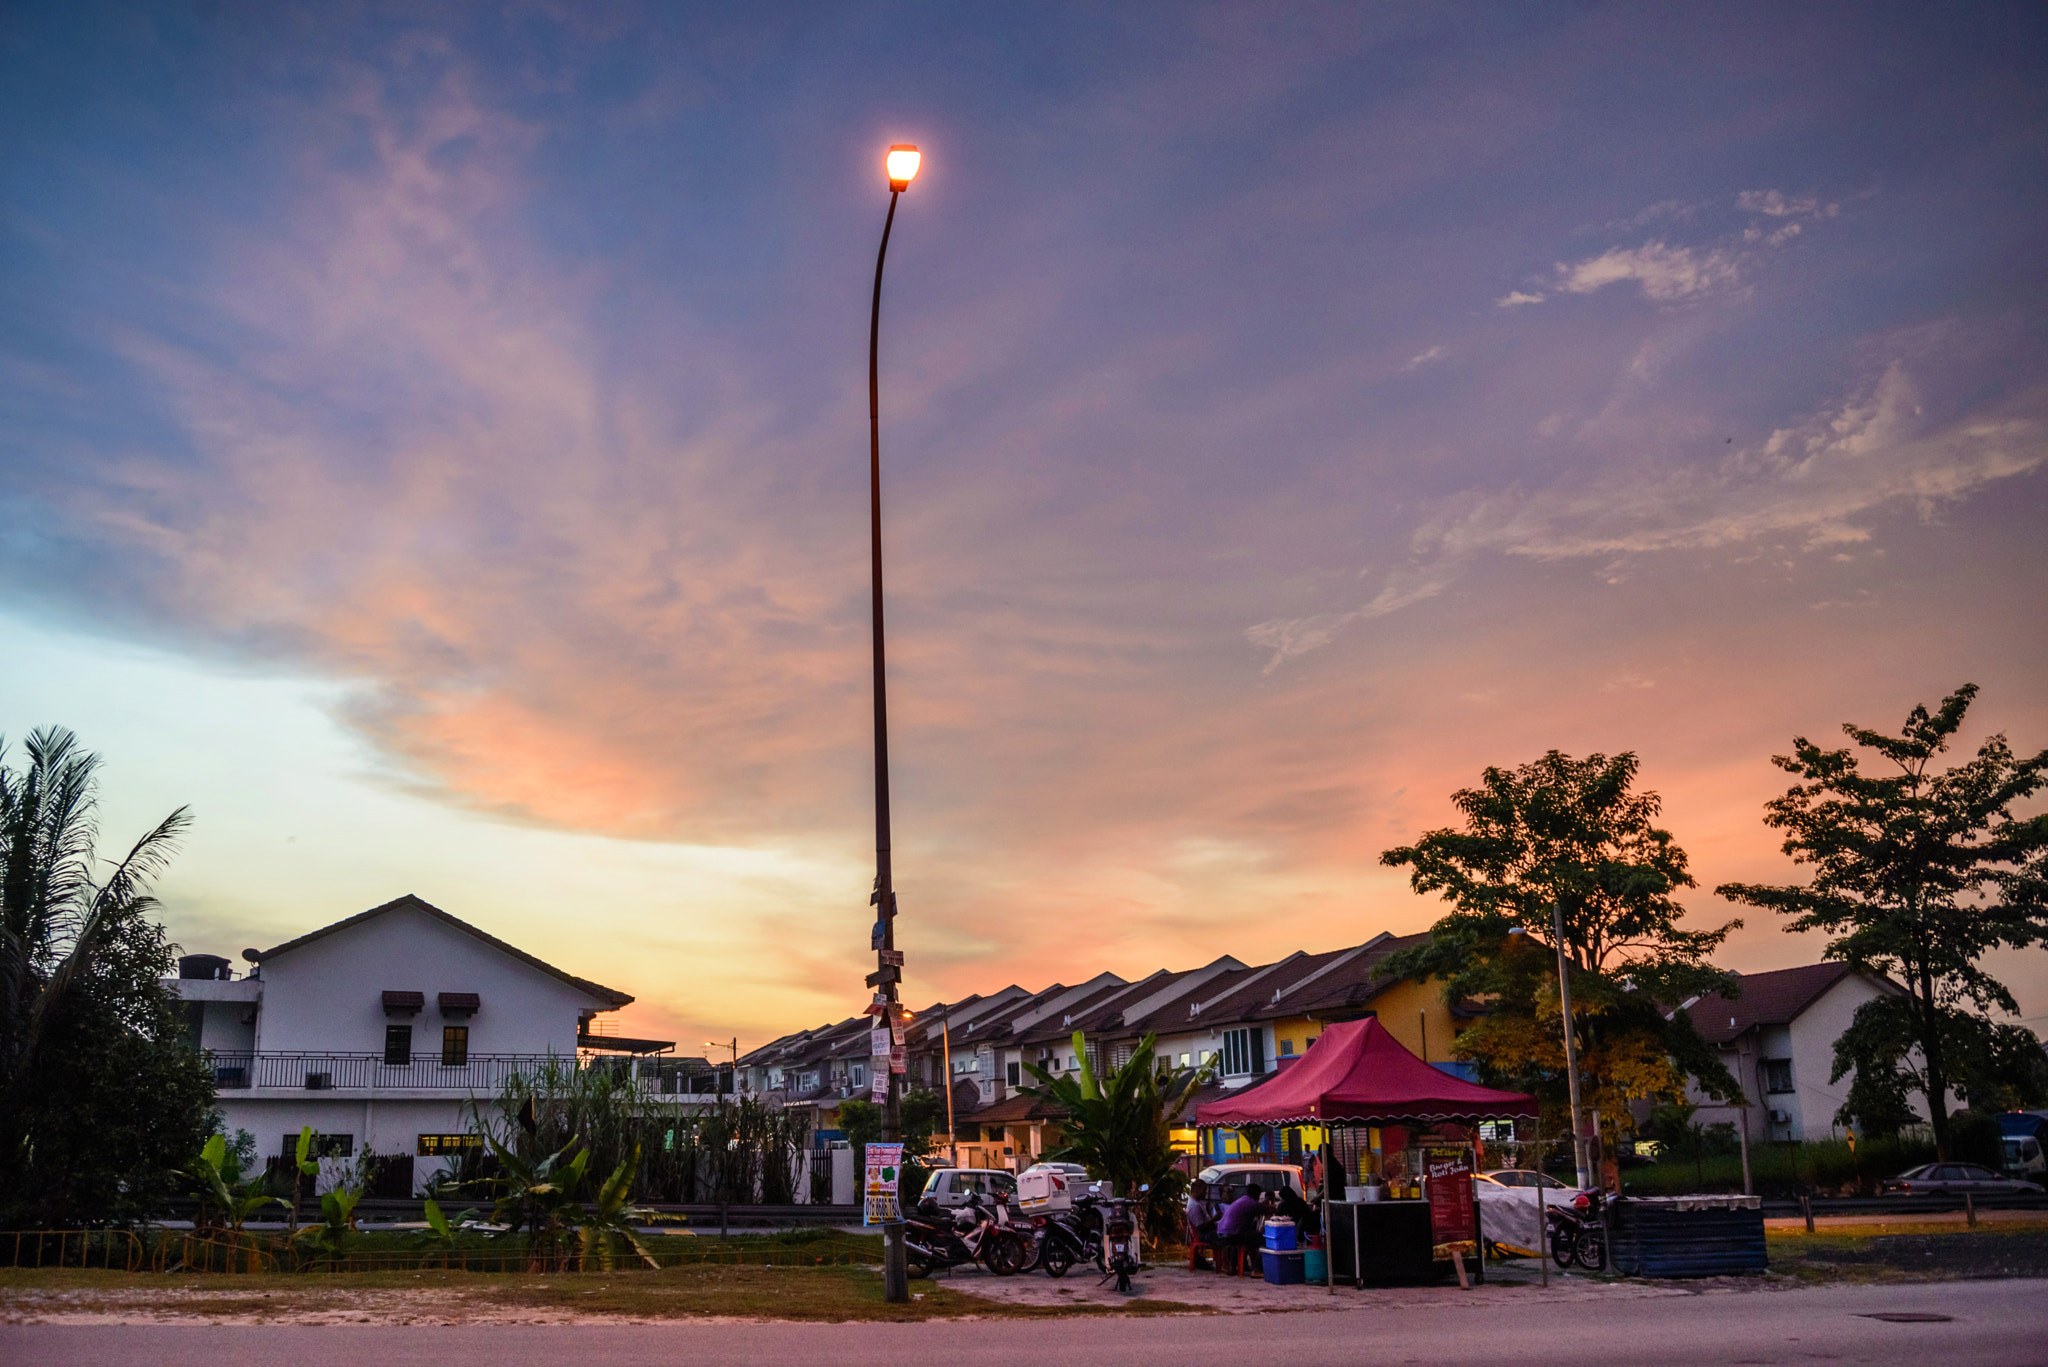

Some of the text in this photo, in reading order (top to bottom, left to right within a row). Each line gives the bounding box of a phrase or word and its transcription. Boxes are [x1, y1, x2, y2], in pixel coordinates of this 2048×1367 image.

[1430, 1161, 1455, 1172] Burger
[1432, 1165, 1469, 1178] Roti John
